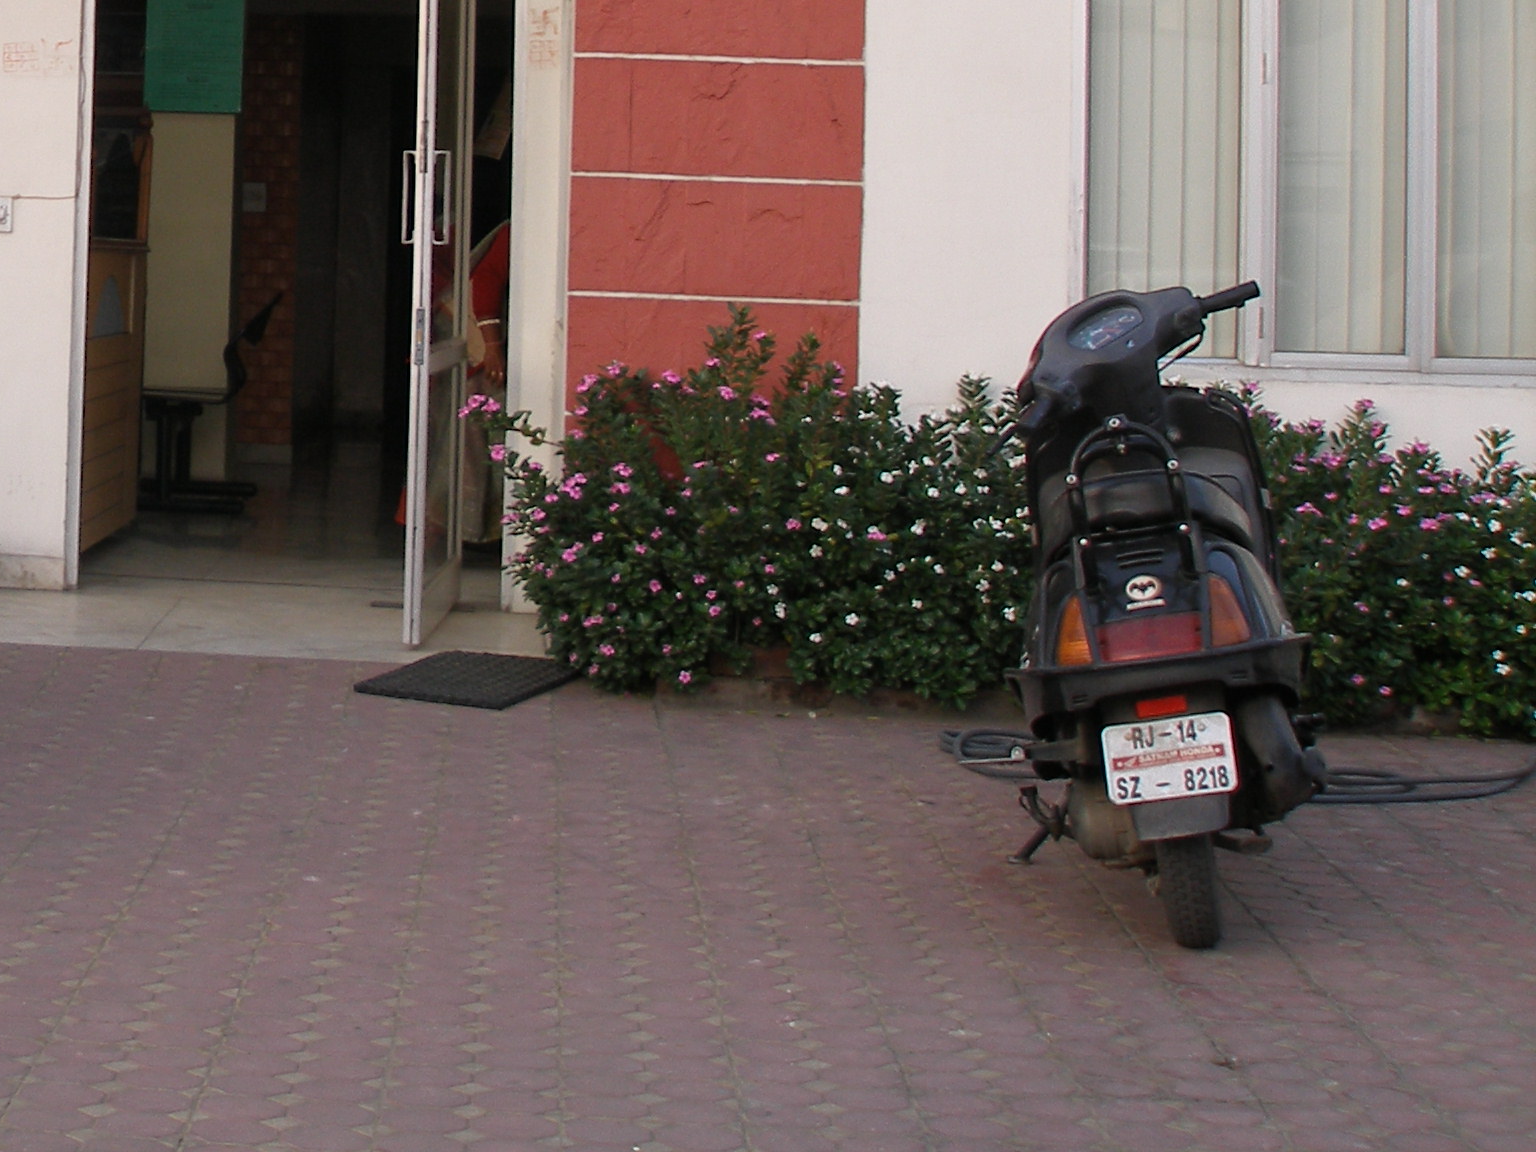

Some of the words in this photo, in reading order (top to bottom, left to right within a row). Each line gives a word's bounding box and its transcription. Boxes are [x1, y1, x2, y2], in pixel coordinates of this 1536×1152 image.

[1179, 745, 1214, 757] HONDA
[1116, 776, 1142, 799] SZ
[1184, 765, 1229, 791] 8218
